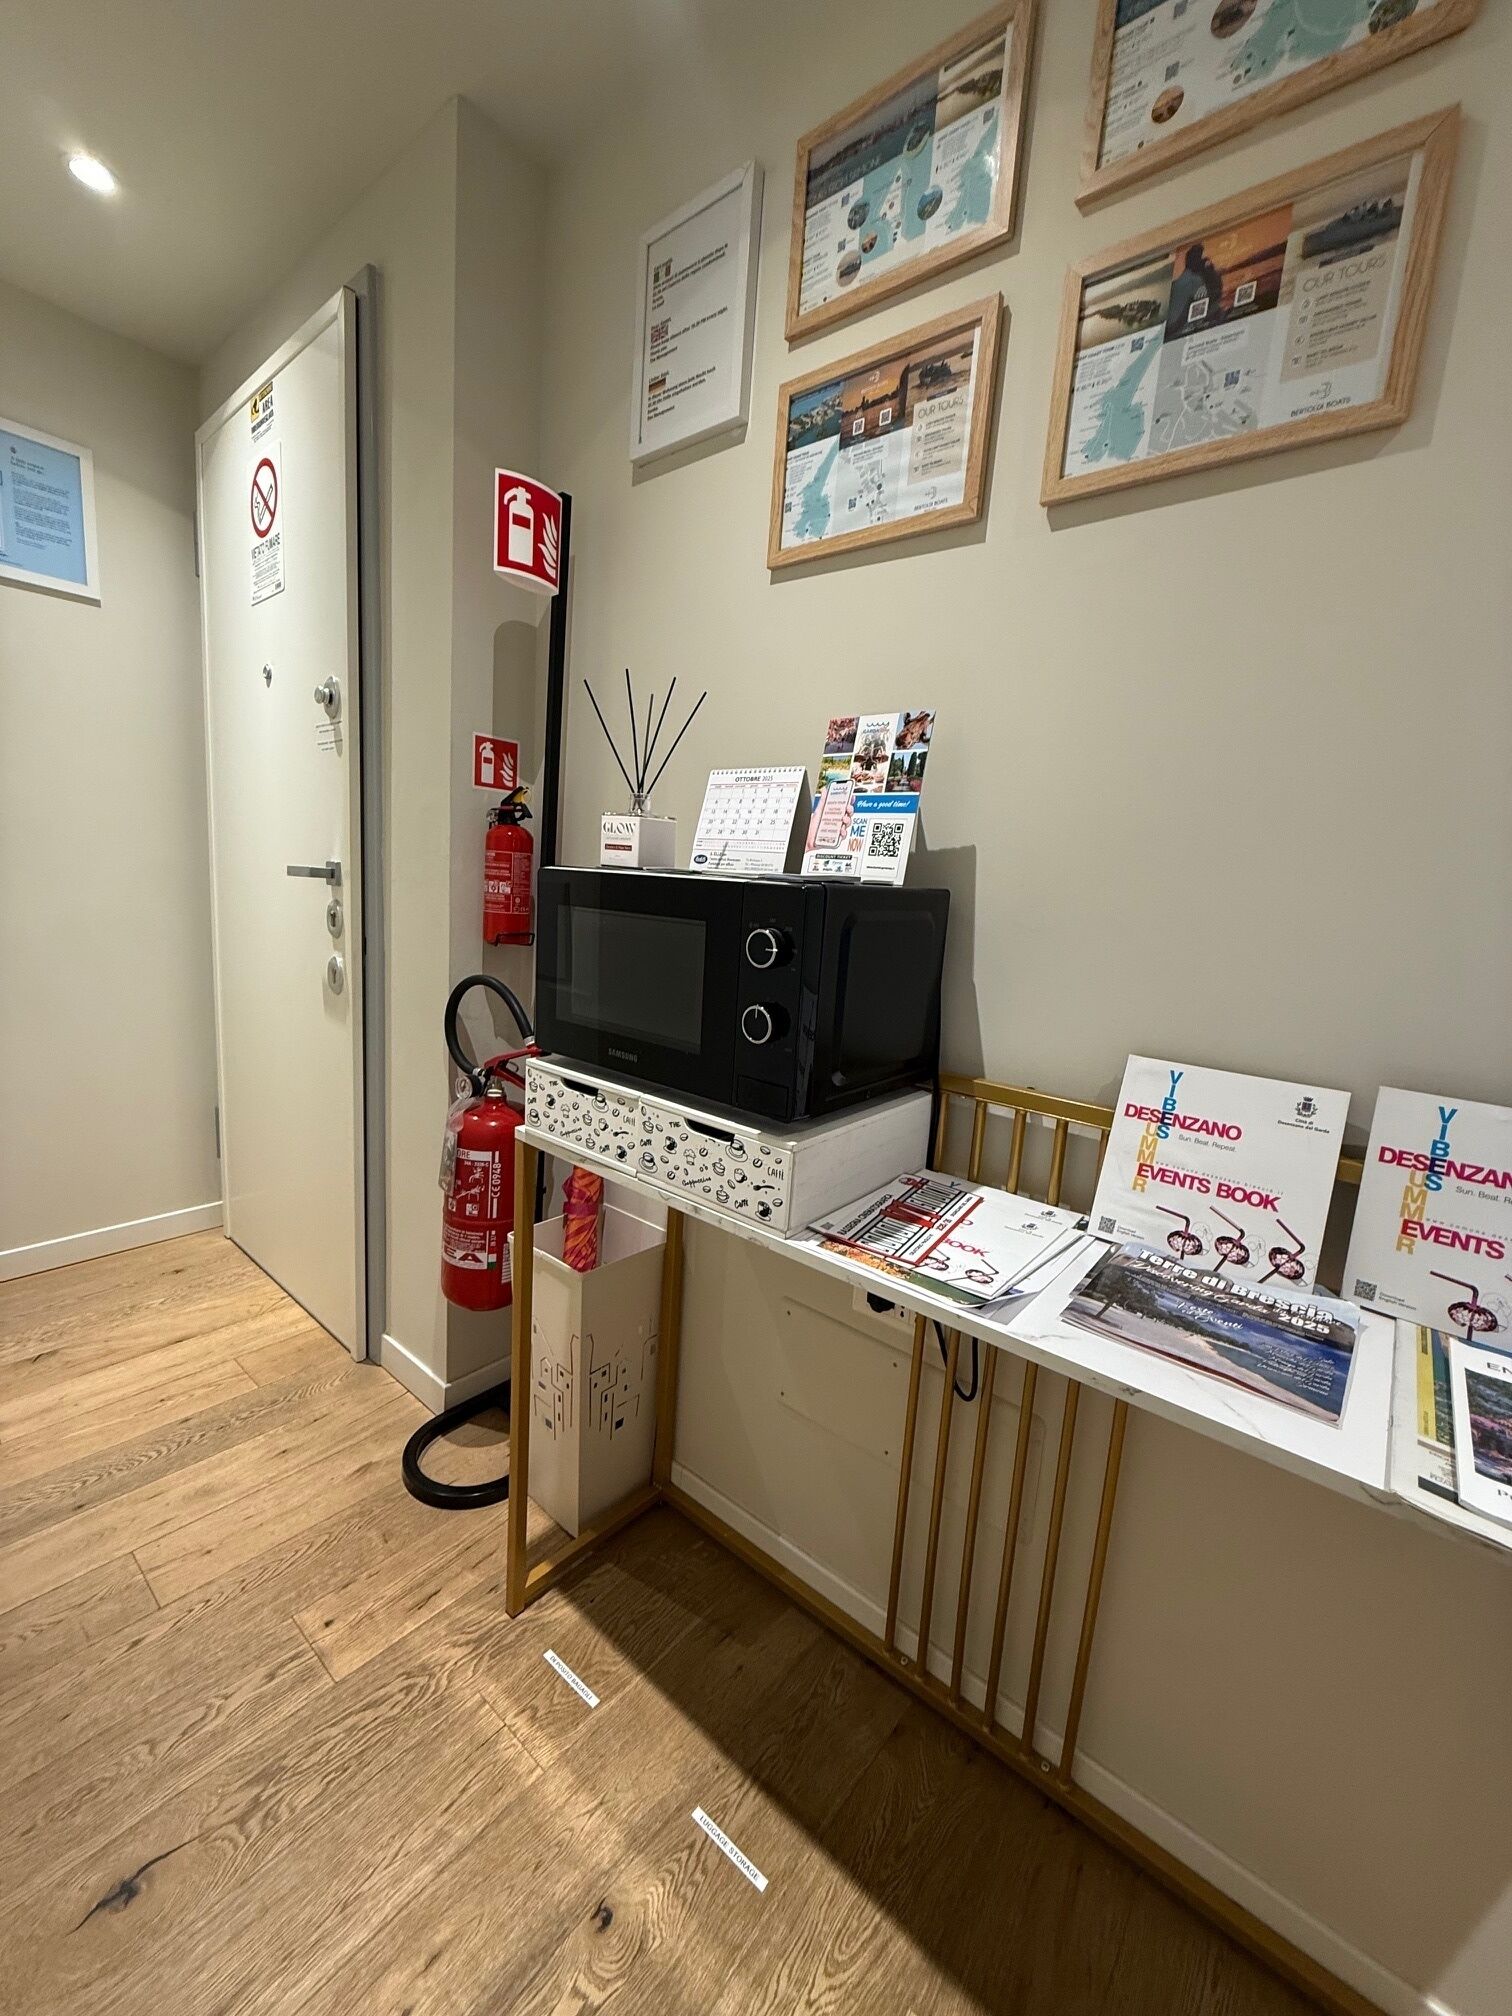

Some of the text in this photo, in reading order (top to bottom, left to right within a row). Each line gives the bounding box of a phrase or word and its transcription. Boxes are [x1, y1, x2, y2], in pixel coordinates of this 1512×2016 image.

[918, 404, 936, 419] OUR
[857, 800, 872, 808] Have
[877, 800, 894, 810] good
[893, 800, 910, 808] time!
[603, 821, 636, 834] GLOW
[850, 826, 866, 837] ME
[847, 838, 863, 852] NOW
[608, 1048, 638, 1063] SAMSUNG
[1124, 1102, 1243, 1141] DESENZANO
[1178, 1134, 1192, 1143] Sun.
[1136, 1162, 1282, 1213] EVENTS BOOK
[1455, 1185, 1475, 1198] Sun.
[1401, 1218, 1505, 1260] EVENTS
[1139, 1249, 1336, 1323] Terre di Brescia
[1278, 1312, 1330, 1335] 2025
[549, 1655, 593, 1701] DEPOSITO BAGAGLI
[699, 1815, 760, 1880] LUGGAGE STORAGE
